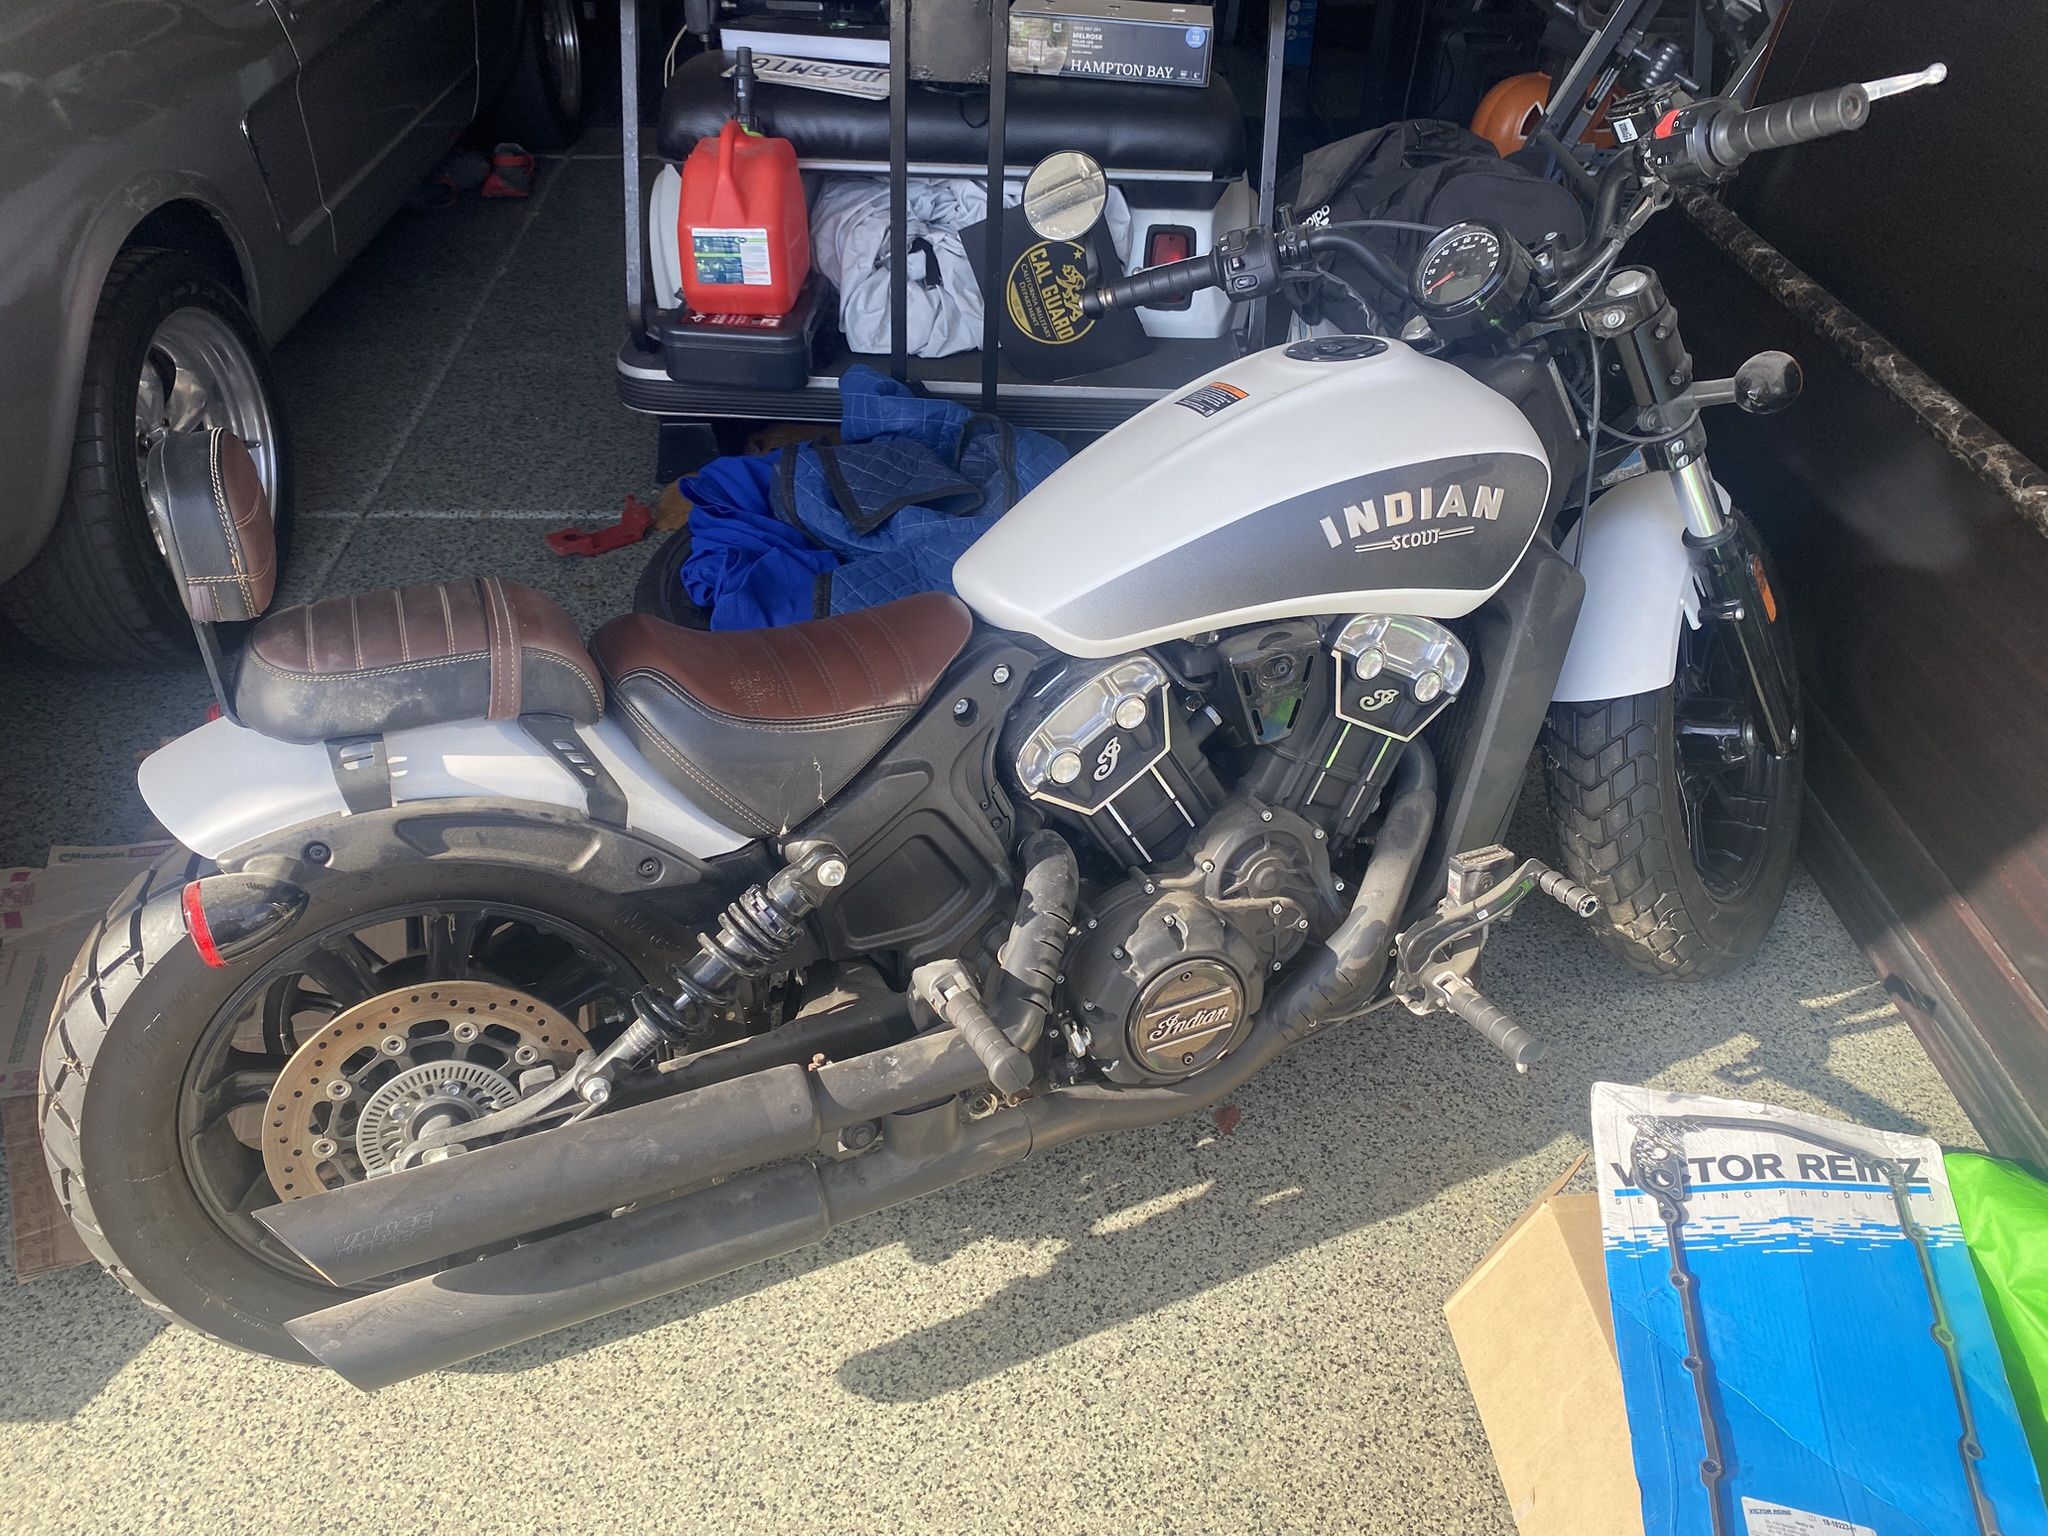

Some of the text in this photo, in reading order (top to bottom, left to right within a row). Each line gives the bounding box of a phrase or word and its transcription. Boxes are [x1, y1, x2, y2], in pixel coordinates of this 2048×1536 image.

[1072, 32, 1103, 41] MELROSE
[1071, 59, 1143, 76] HAMPTON
[1147, 66, 1173, 79] BAY
[1020, 282, 1040, 327] DEPARTMENT
[1021, 264, 1052, 338] CALIFORNIA MILITARY
[1030, 248, 1075, 340] CAL GUARD
[1320, 484, 1505, 548] INDIAN
[1392, 528, 1441, 551] SCOUT
[1149, 1006, 1229, 1041] Indian
[1610, 1153, 1785, 1187] VTOR
[1615, 1192, 1752, 1205] SEING
